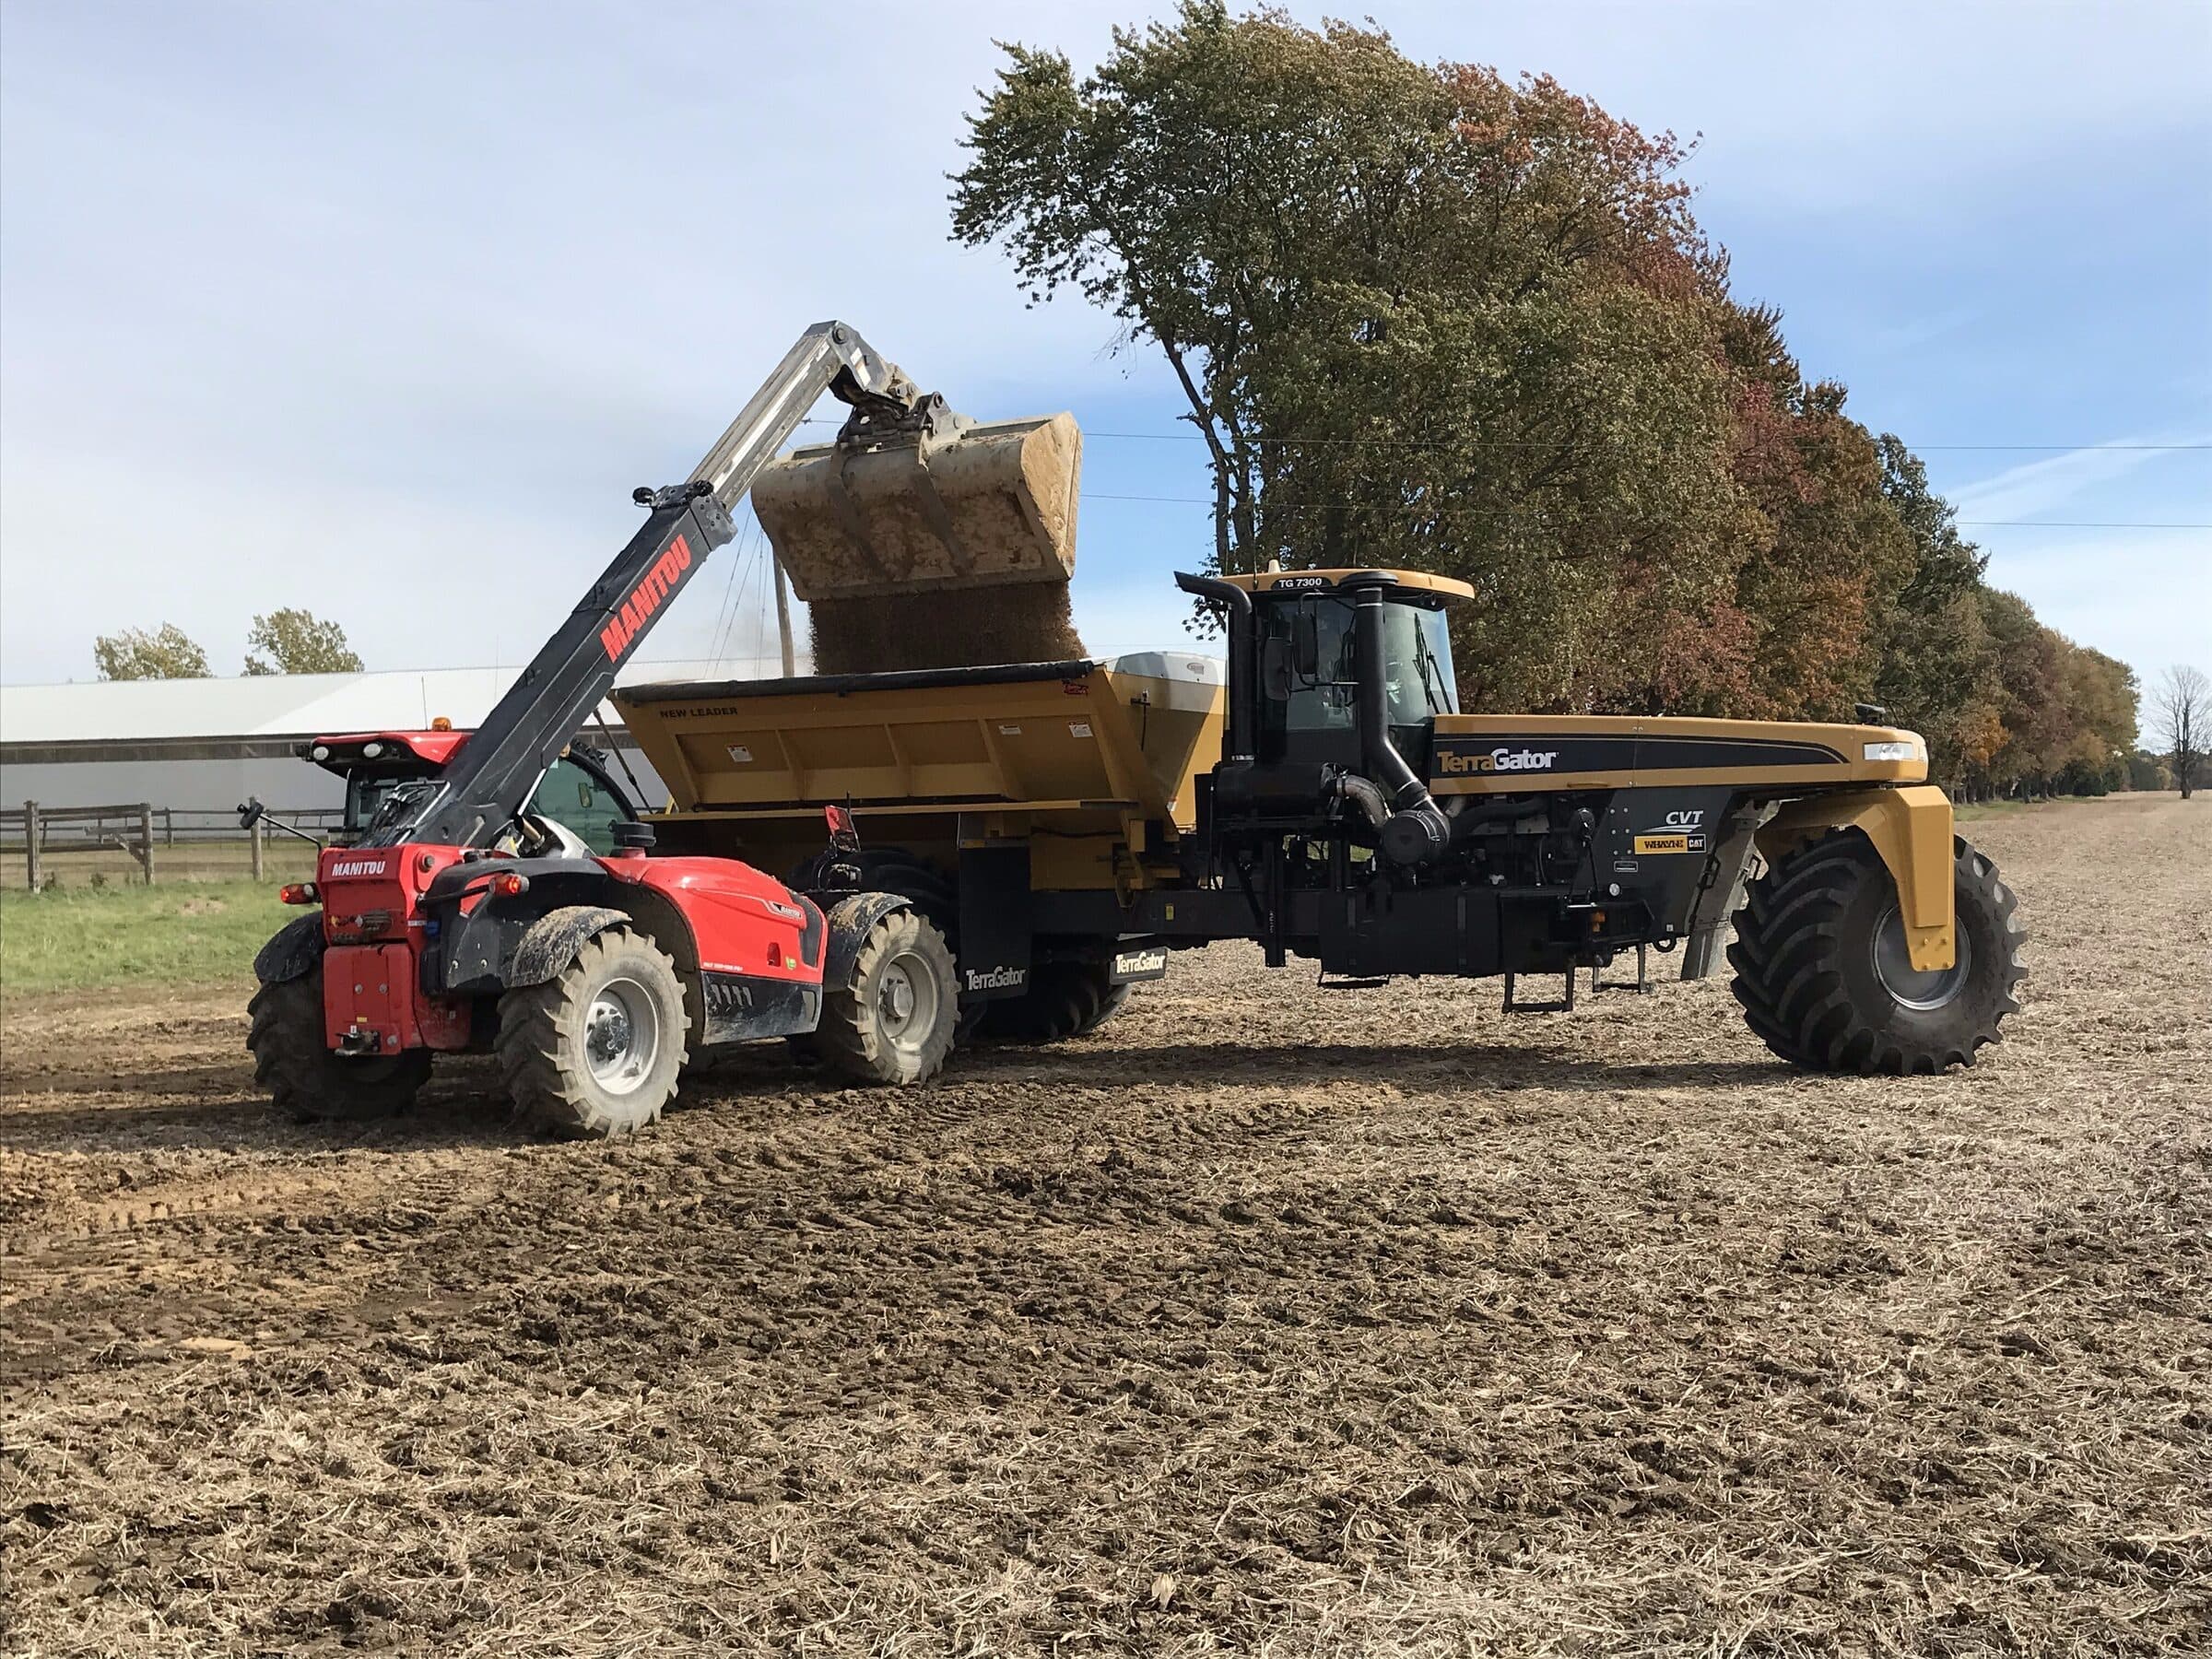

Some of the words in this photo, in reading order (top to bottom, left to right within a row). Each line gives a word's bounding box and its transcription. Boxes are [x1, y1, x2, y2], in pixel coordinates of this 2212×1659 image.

[1278, 579, 1294, 588] TG
[1296, 577, 1322, 587] 7300
[600, 534, 691, 664] MANITOU
[660, 709, 687, 718] NEW
[690, 707, 738, 717] LEADER
[1437, 748, 1557, 773] TerraGator
[1665, 810, 1704, 825] CVT
[1688, 839, 1704, 848] CAT
[332, 861, 386, 877] MANITOU
[1115, 951, 1165, 974] TerraGator
[966, 966, 1026, 991] TerraGator
